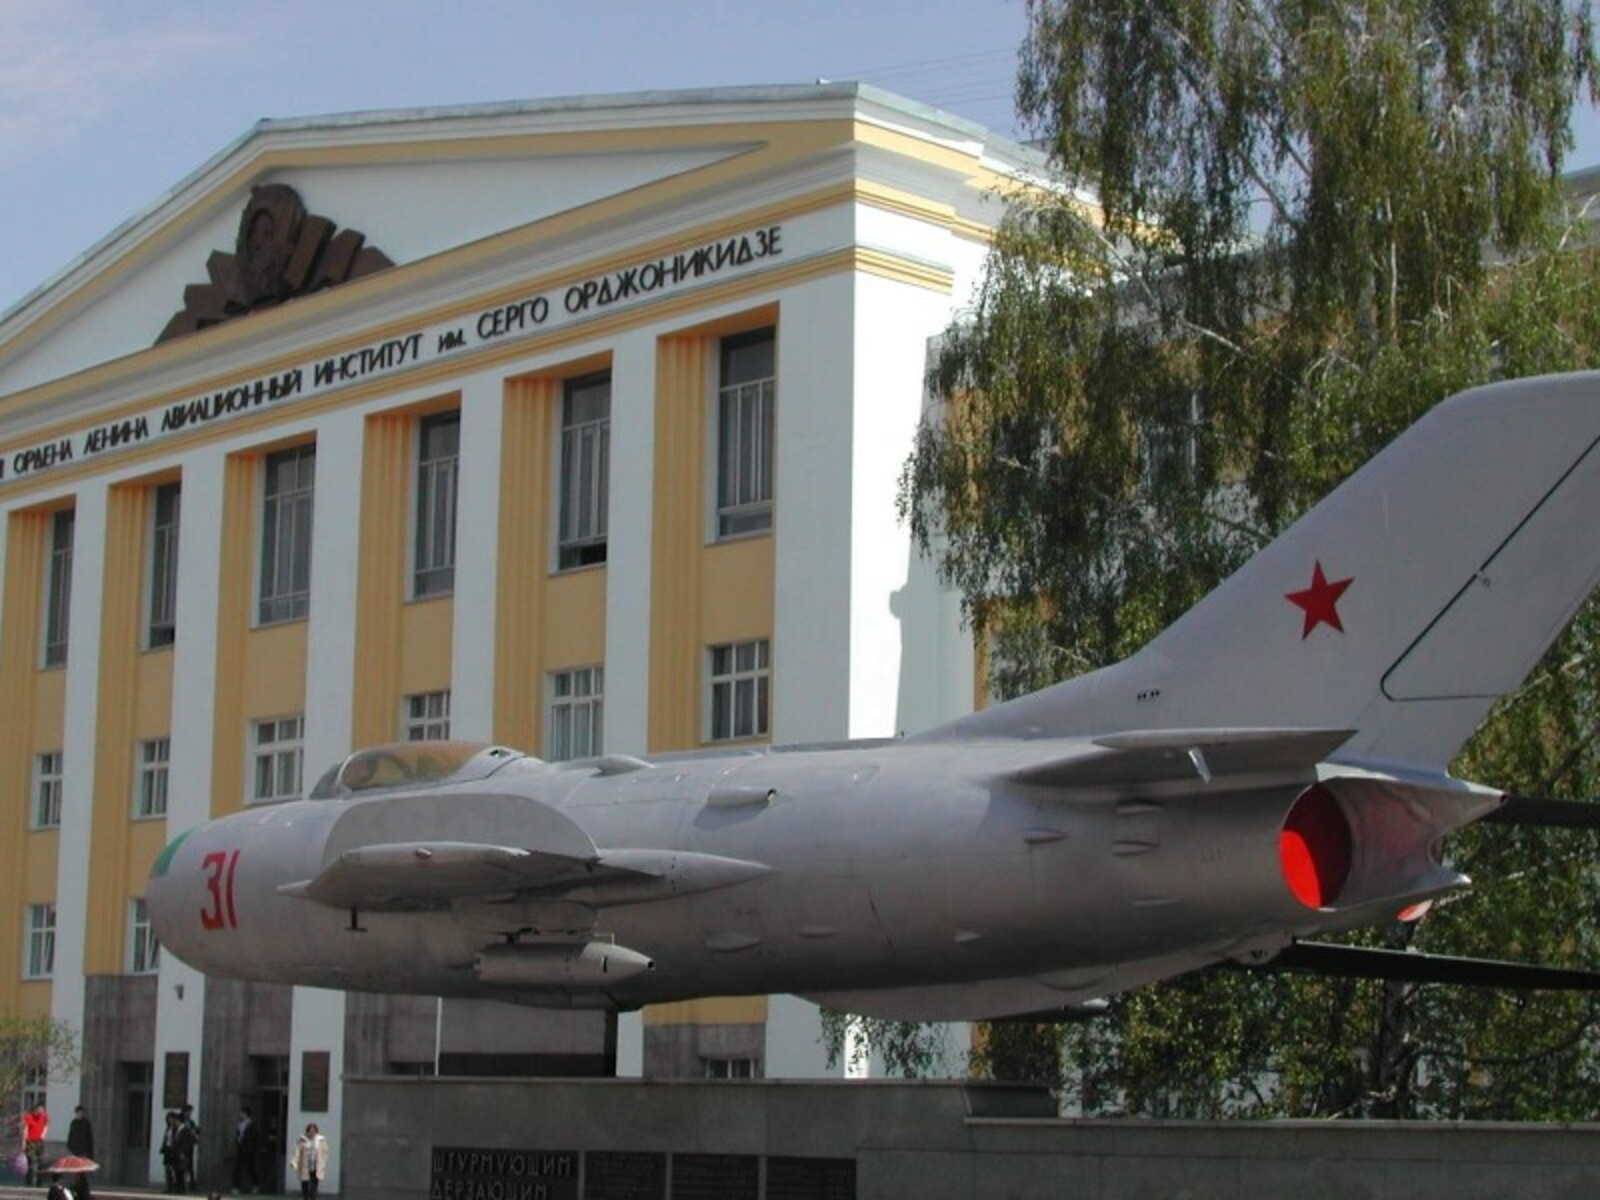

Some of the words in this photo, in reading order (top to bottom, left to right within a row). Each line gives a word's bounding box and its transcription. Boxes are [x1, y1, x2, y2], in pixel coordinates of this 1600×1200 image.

[14, 438, 73, 474] ОРДЕНА
[83, 416, 149, 455] ЛЕНИНА
[161, 369, 303, 433] АВИАЦИОННЫЙ
[314, 333, 423, 388] ИНСТИТУТ
[477, 297, 549, 339] СЕРГО
[564, 226, 782, 313] ОРДЖОНИКИДЗЕ
[201, 850, 240, 930] 31
